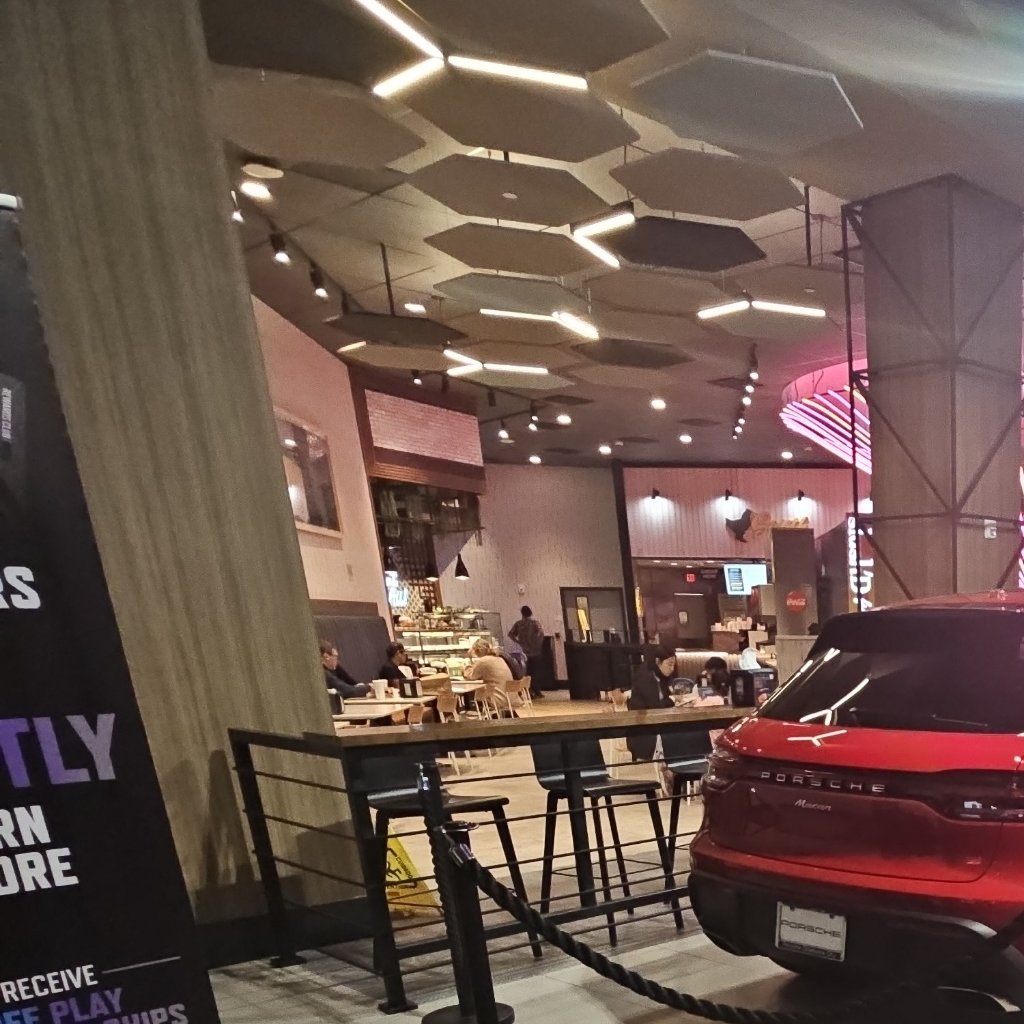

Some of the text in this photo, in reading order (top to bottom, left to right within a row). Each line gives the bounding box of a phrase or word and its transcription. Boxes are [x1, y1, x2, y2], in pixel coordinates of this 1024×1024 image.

[0, 565, 41, 609] S
[761, 771, 886, 793] PORSCHE
[0, 964, 98, 1003] RECEIVE
